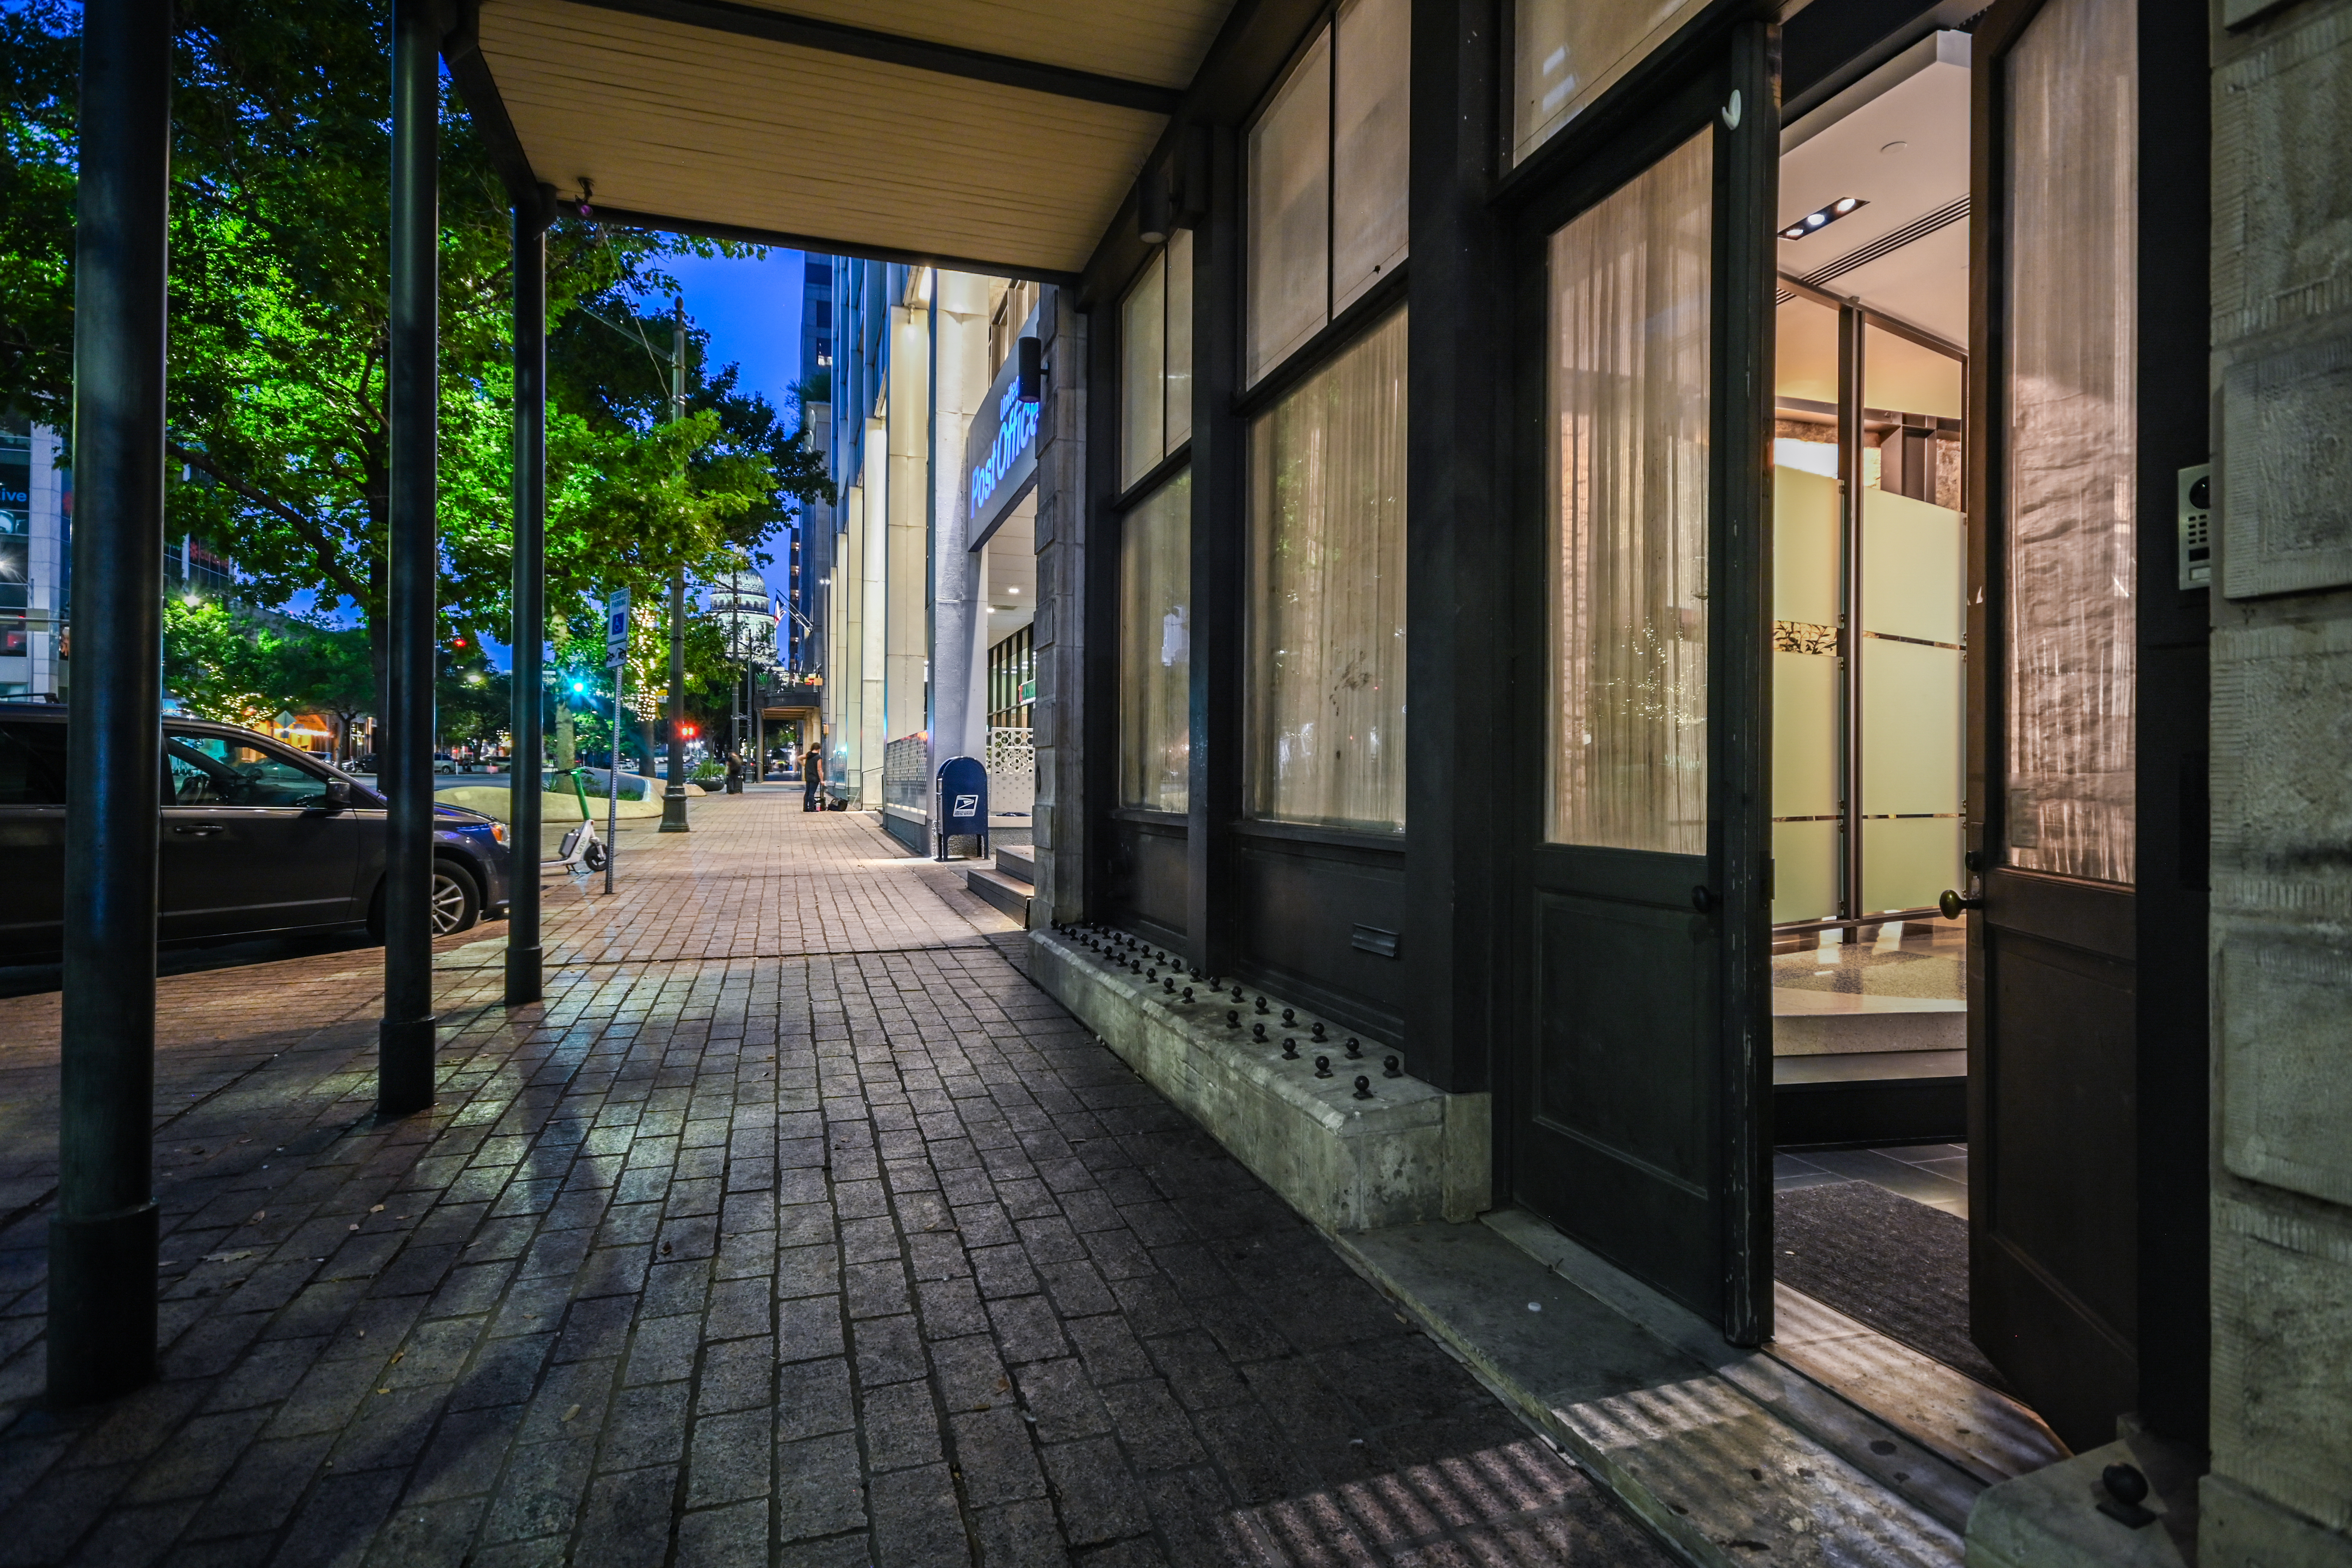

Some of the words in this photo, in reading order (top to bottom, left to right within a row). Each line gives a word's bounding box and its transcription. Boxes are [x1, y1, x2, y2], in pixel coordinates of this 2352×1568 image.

[971, 439, 996, 519] Post
[997, 400, 1039, 480] Office
[0, 488, 27, 502] ive
[611, 590, 627, 601] RESERVED
[612, 598, 626, 609] PARKING
[575, 837, 586, 854] Lime
